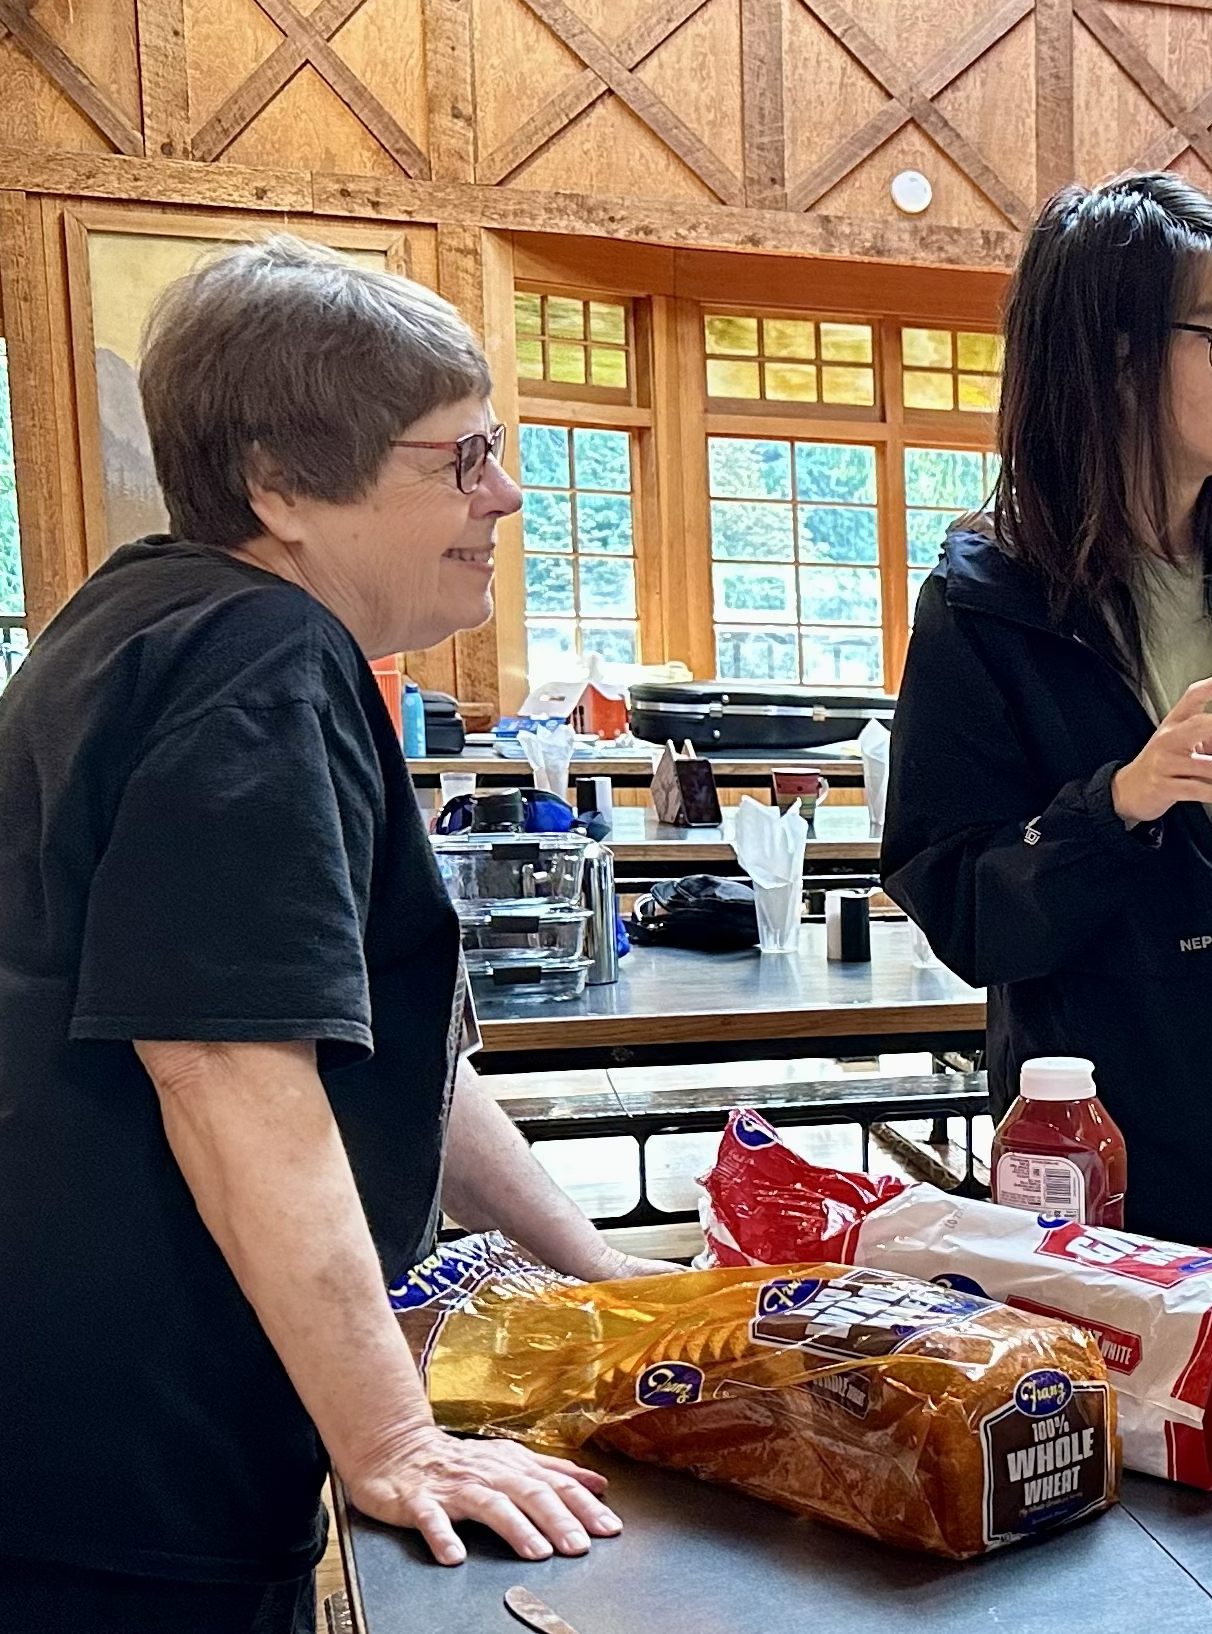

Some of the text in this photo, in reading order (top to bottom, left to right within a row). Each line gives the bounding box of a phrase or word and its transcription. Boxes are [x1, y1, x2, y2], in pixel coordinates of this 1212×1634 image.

[1032, 1414, 1070, 1442] 100%
[1007, 1427, 1095, 1483] WHOLE
[1024, 1465, 1081, 1506] WHEAT
